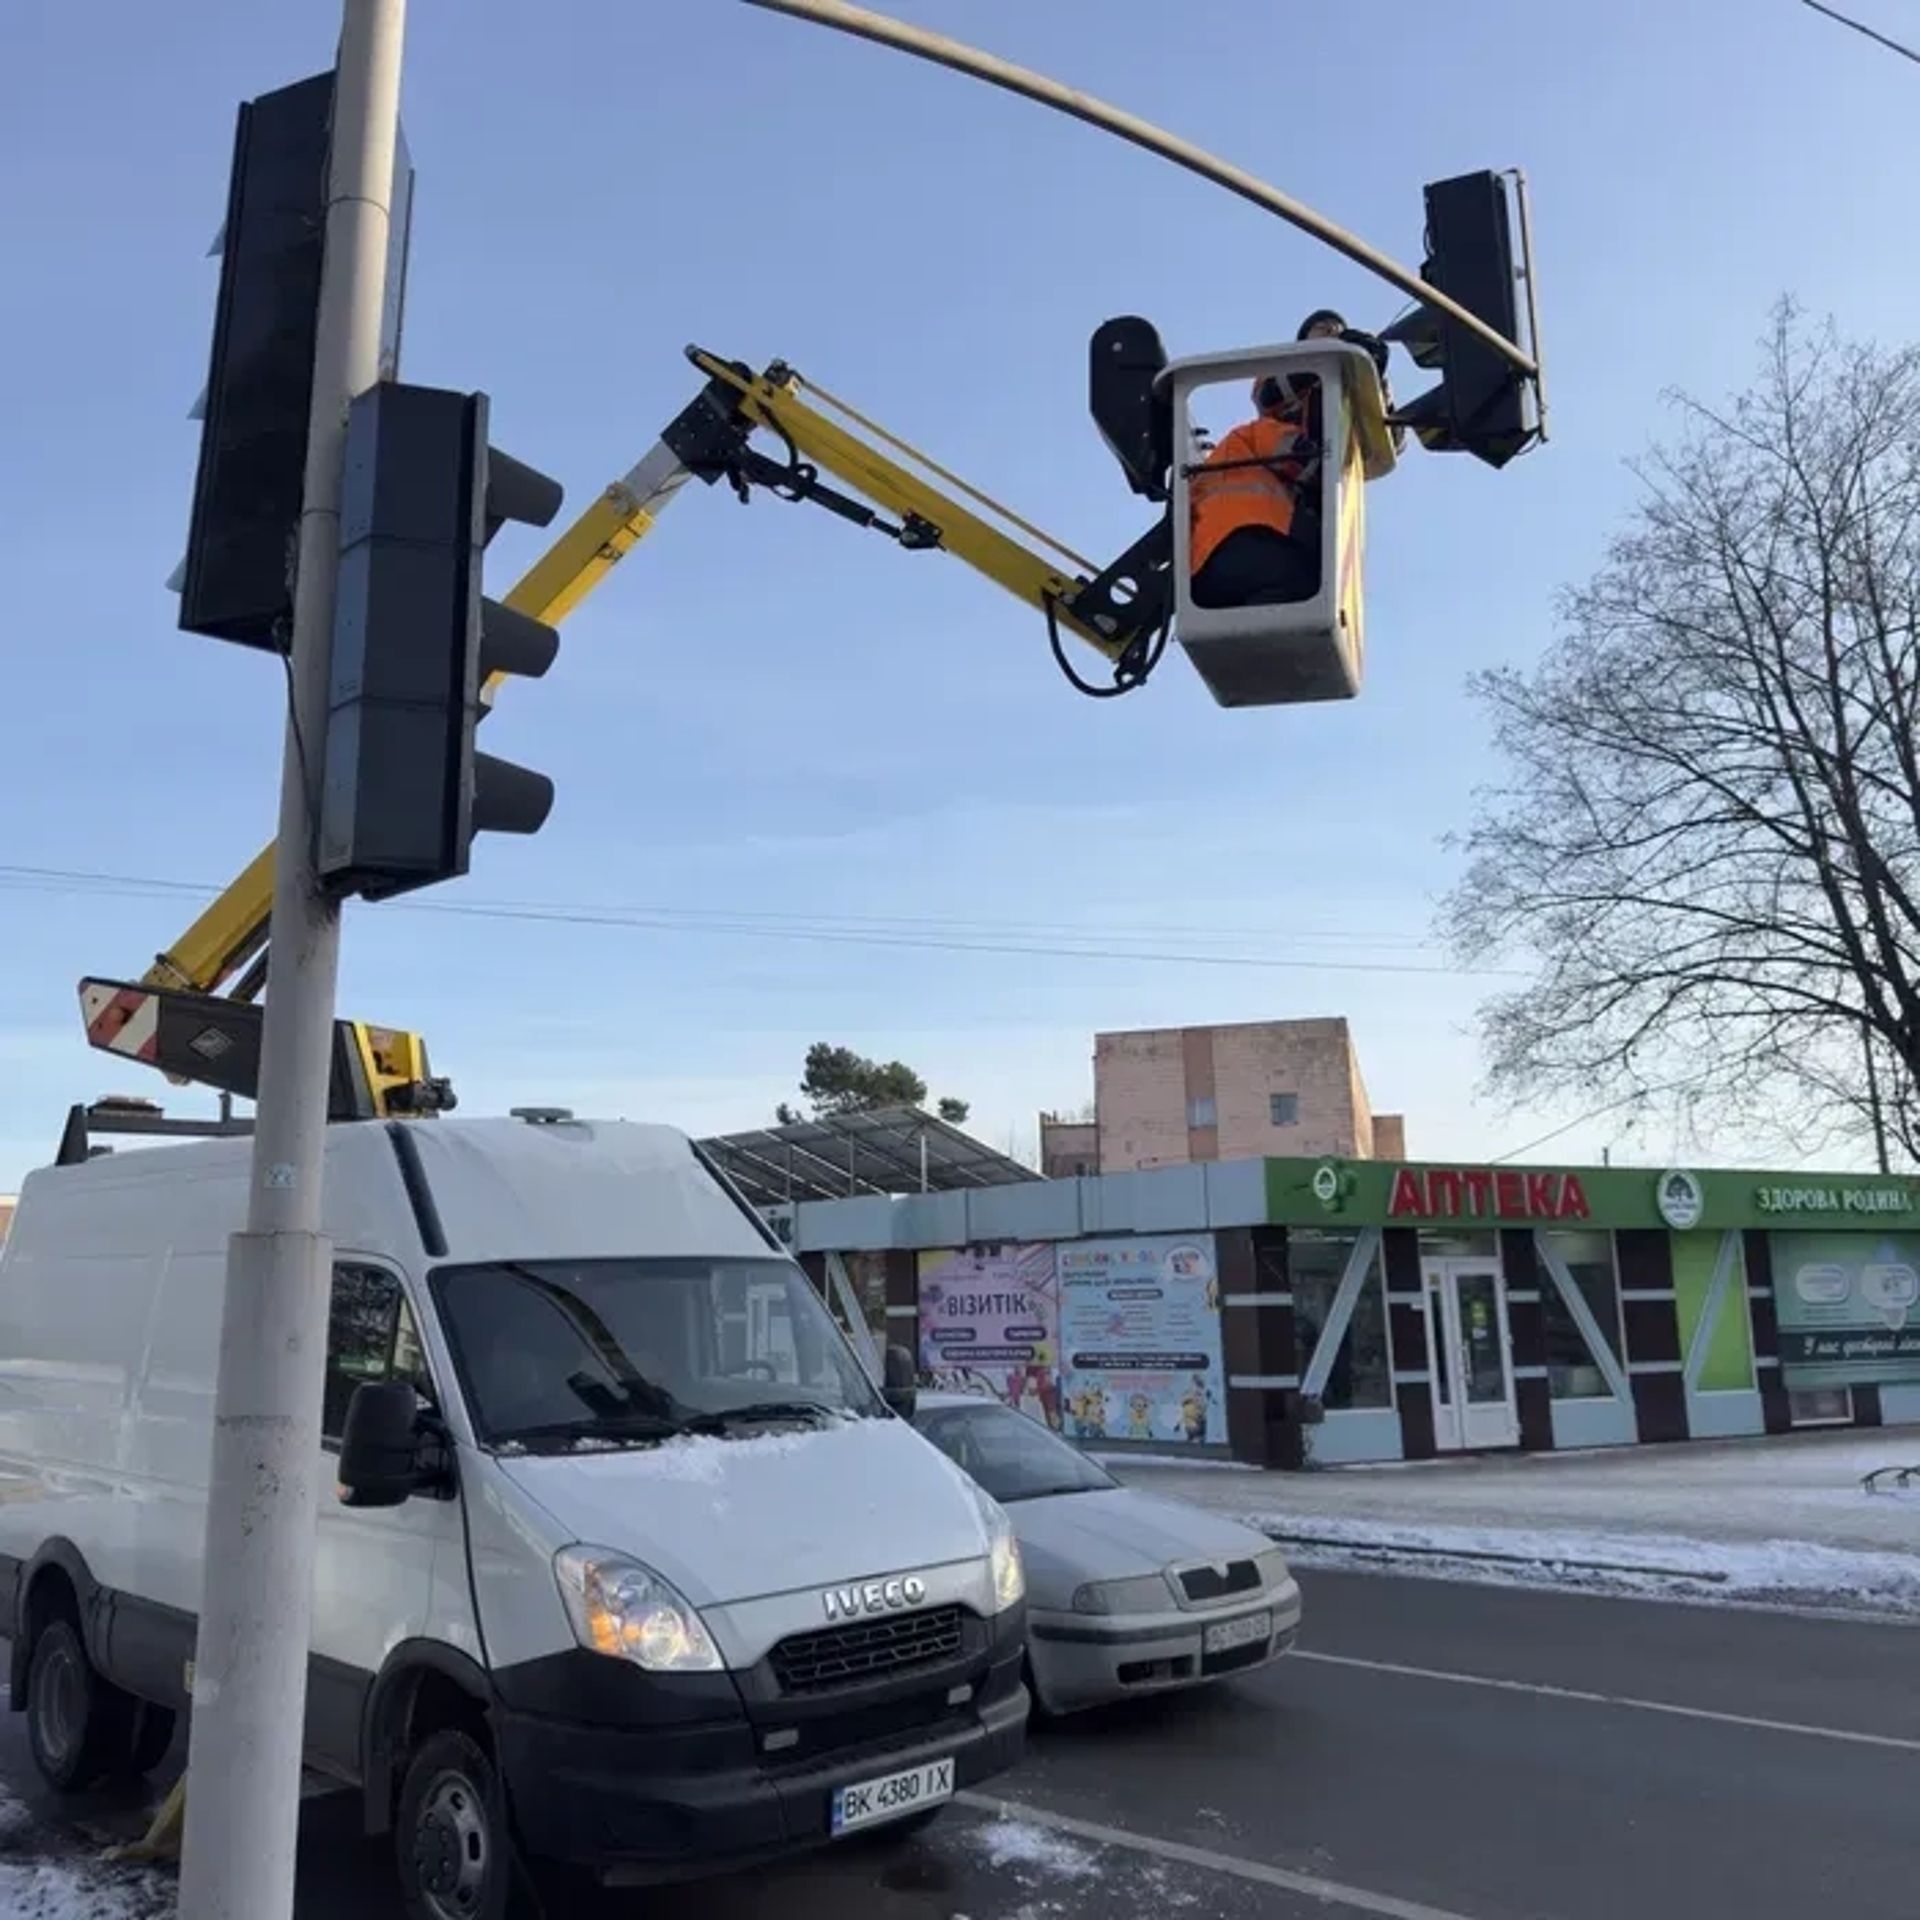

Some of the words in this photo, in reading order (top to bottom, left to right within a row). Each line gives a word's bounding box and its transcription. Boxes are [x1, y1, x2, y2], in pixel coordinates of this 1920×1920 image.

[1386, 1168, 1591, 1221] АПТЕКА
[1757, 1187, 1839, 1212] ЗДОРОВА
[1842, 1188, 1913, 1212] РОДИНА
[822, 1577, 925, 1620] IVECO
[845, 1787, 872, 1819] BK
[878, 1773, 919, 1807] 4380
